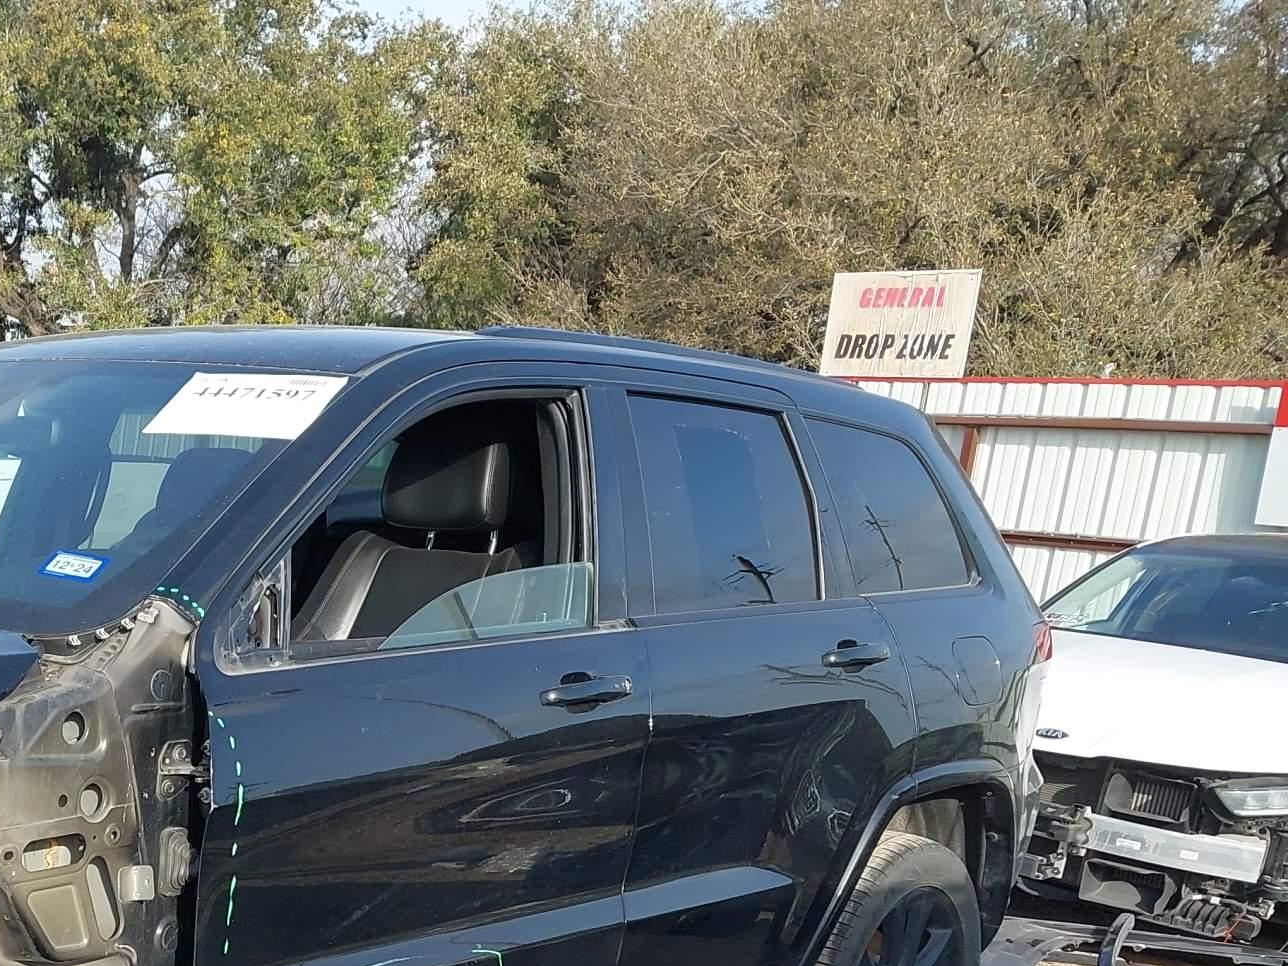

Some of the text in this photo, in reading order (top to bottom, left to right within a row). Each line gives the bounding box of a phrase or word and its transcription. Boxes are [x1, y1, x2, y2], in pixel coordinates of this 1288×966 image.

[859, 287, 946, 308] GENERAL
[833, 333, 956, 360] DROP ZONE
[193, 386, 316, 400] 44471597
[1037, 727, 1062, 738] KIA
